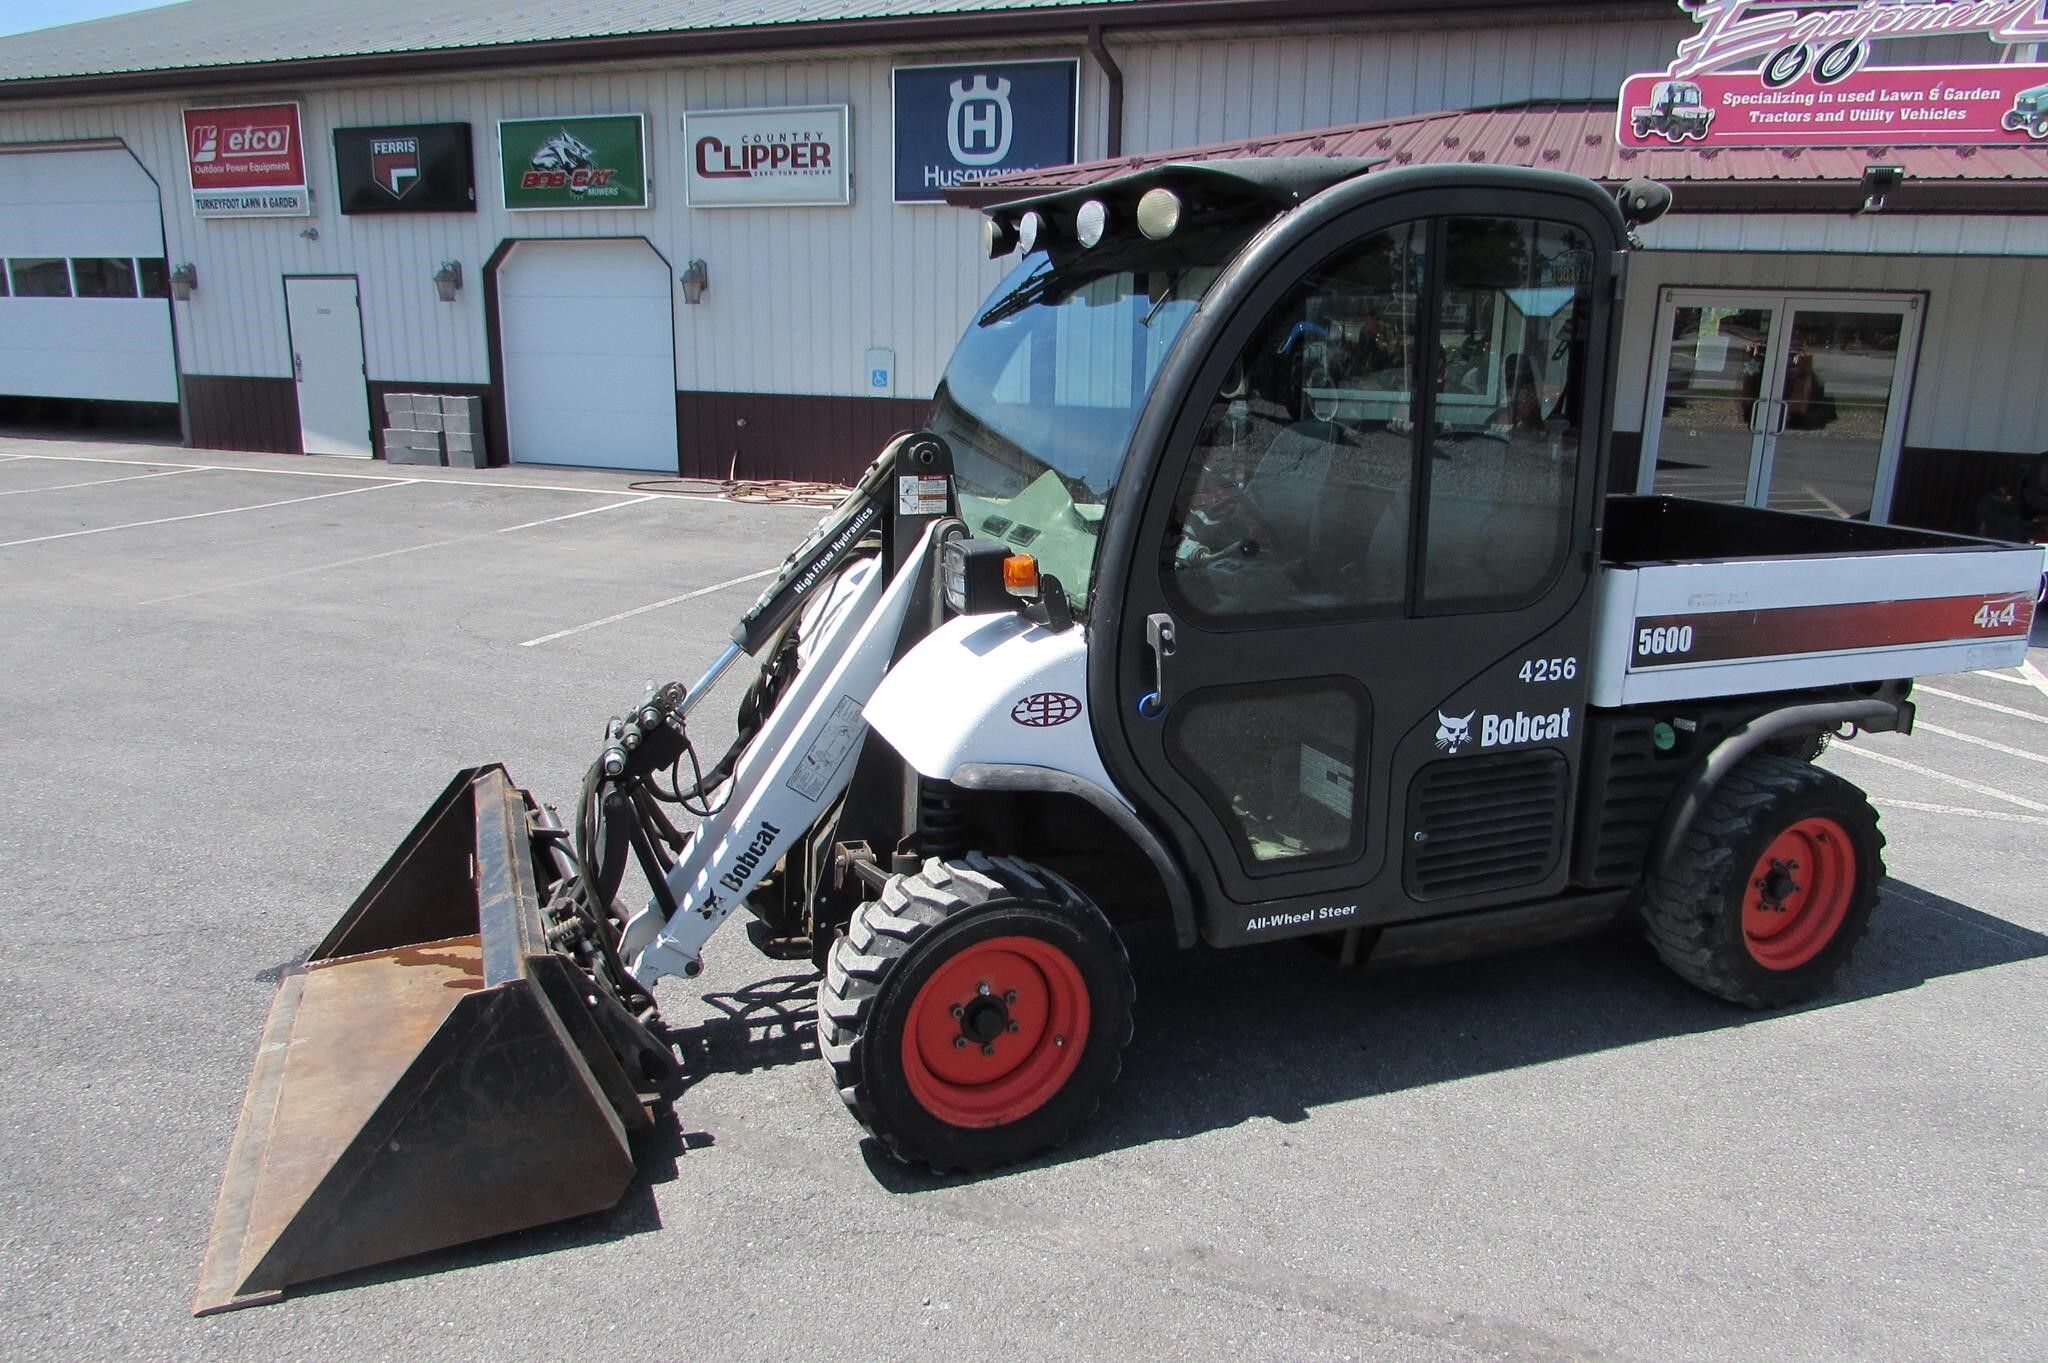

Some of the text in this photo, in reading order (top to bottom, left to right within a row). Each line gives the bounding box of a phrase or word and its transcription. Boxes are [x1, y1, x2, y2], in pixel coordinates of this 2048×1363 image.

[1722, 87, 2001, 107] Specializing in used Lawn & Garden
[1748, 108, 1967, 123] Tractors and Utility Vehicles
[228, 125, 282, 151] efco
[374, 141, 416, 154] FERRIS
[741, 131, 824, 144] COUNTRY
[195, 162, 290, 174] Outdoor Power Equipment
[195, 197, 298, 210] TURKEYFOOT LAWN & GARDEN
[794, 507, 874, 594] High Flow Hydraulics
[1973, 602, 2015, 628] 4x4
[1638, 625, 1693, 655] 5600
[1518, 657, 1577, 683] 4256
[1480, 707, 1570, 747] Bobcat
[719, 821, 781, 893] Bobcat
[1246, 905, 1357, 930] All-Wheel Steer
